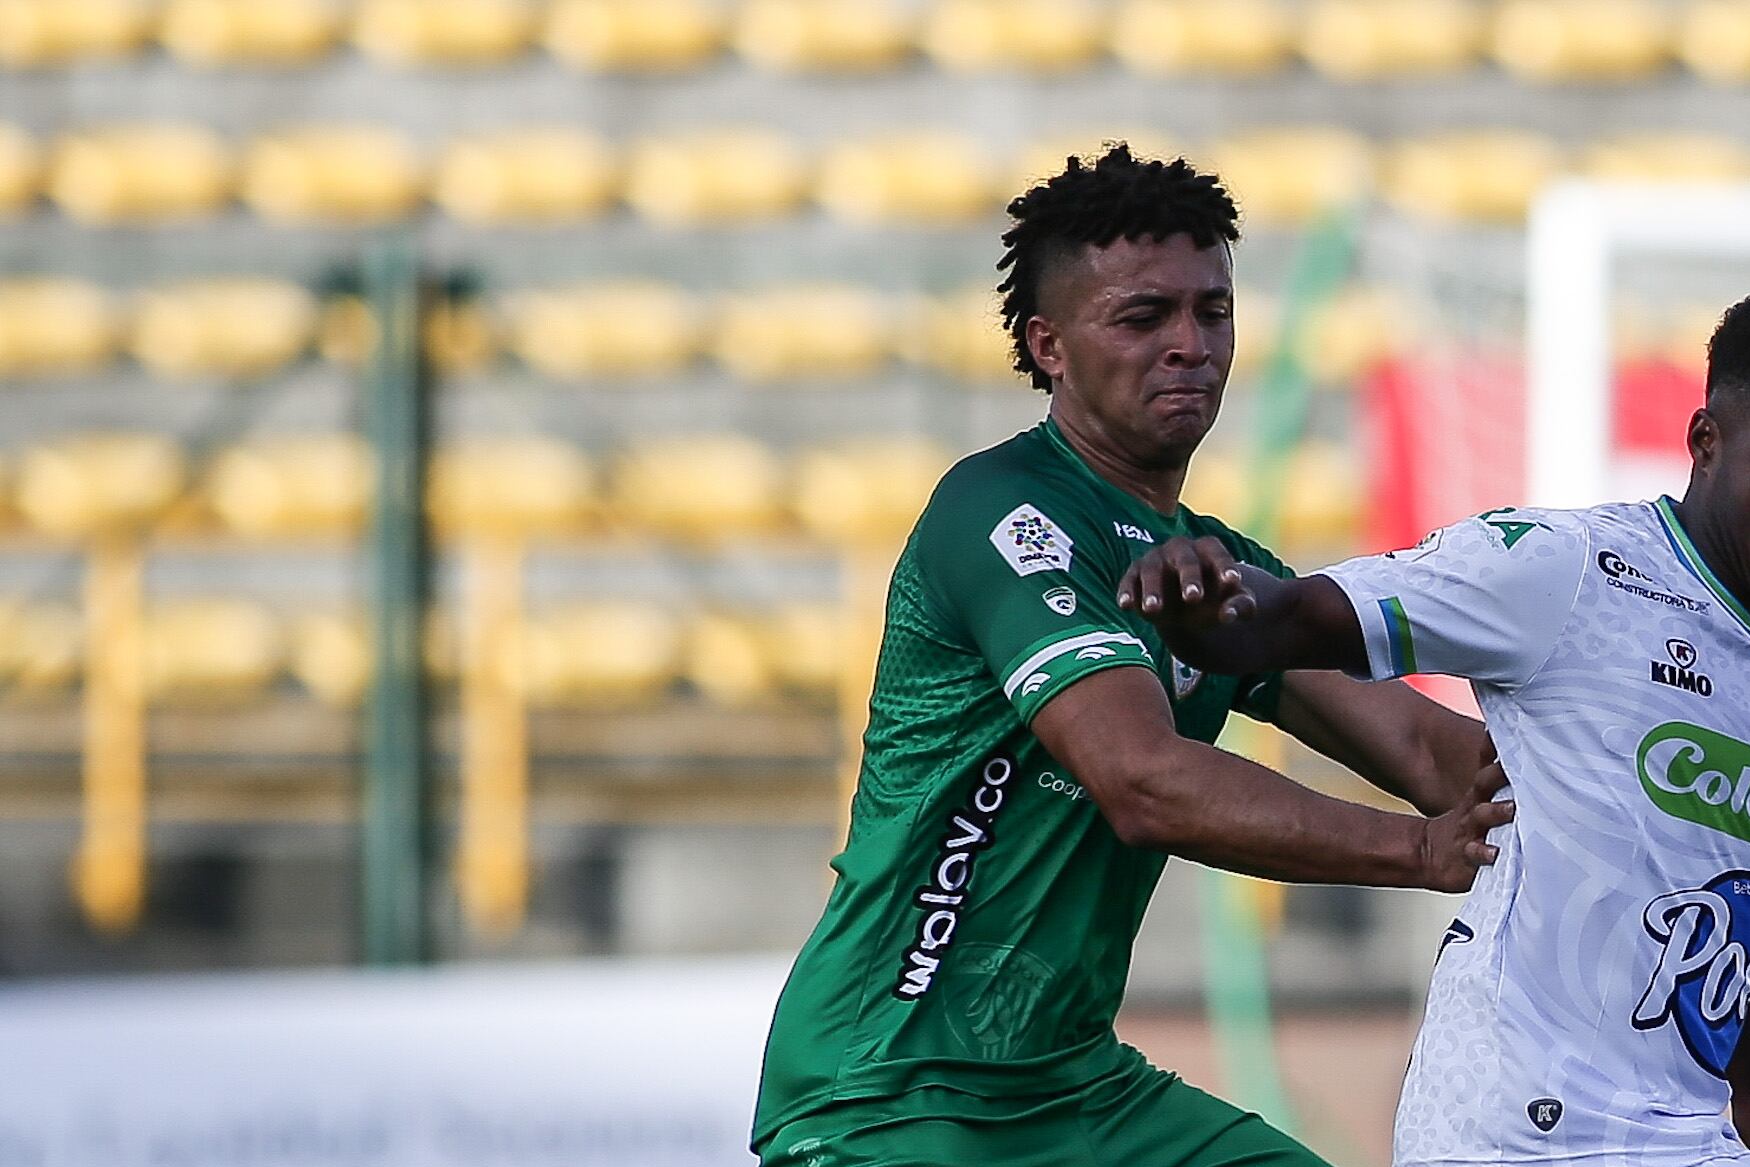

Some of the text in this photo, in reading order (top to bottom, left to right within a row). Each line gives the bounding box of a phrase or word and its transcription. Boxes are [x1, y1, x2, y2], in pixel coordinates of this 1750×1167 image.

[1606, 577, 1687, 609] CONSTRUCTORA
[1650, 660, 1712, 697] KIMO
[1037, 771, 1091, 800] Coop
